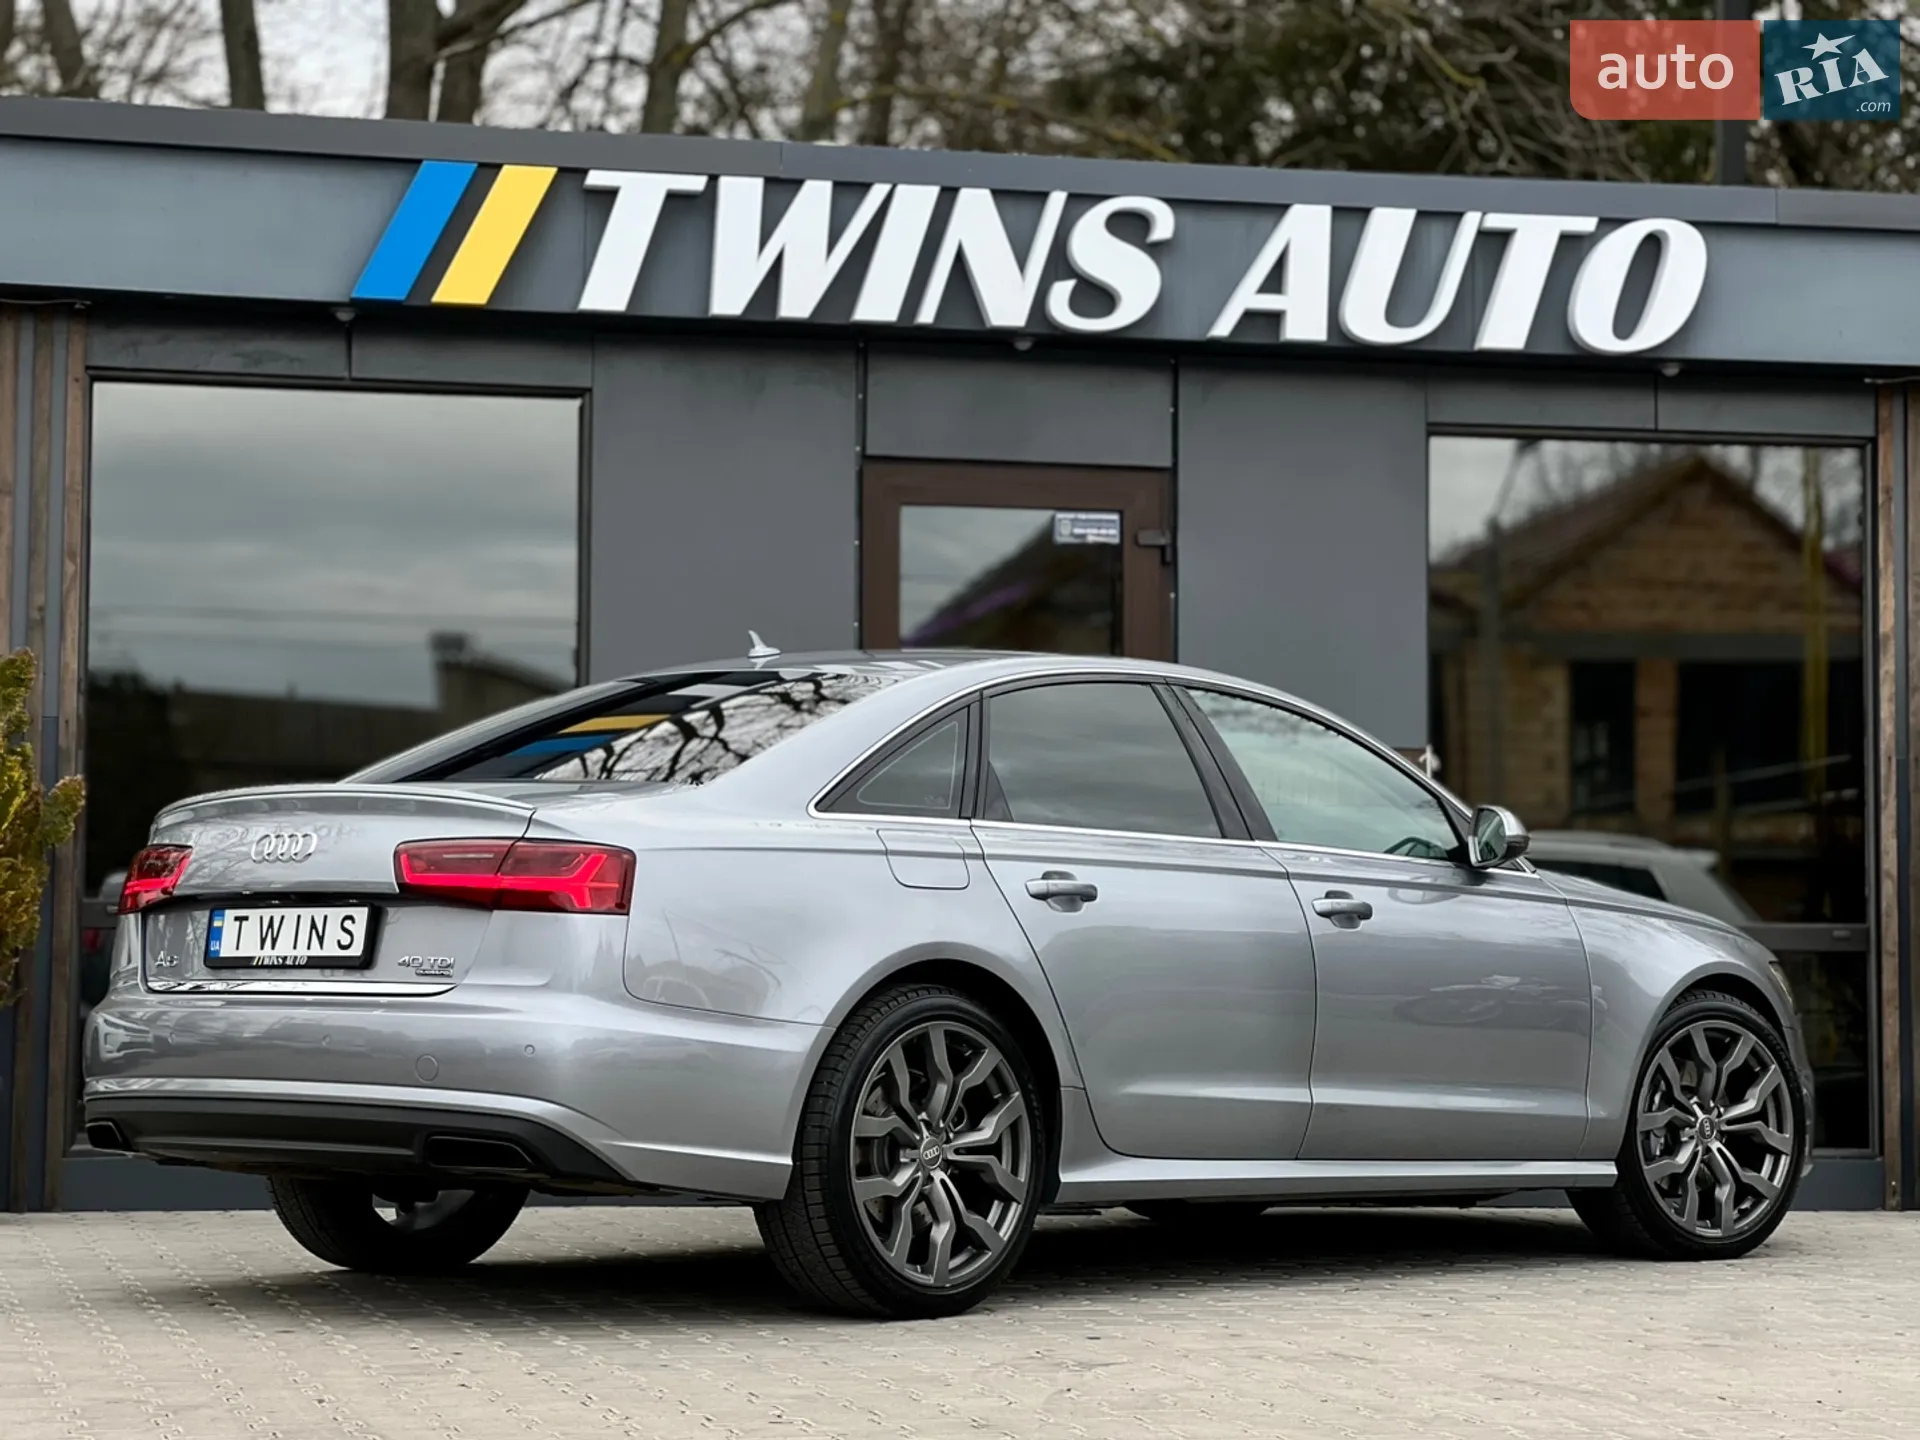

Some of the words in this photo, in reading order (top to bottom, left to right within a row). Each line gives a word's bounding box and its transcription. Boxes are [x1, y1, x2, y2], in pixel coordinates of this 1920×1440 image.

[577, 169, 1175, 332] TWINS
[1206, 203, 1708, 353] AUTO
[233, 914, 356, 951] TWINS
[398, 955, 423, 967] 40
[427, 957, 455, 969] TDI
